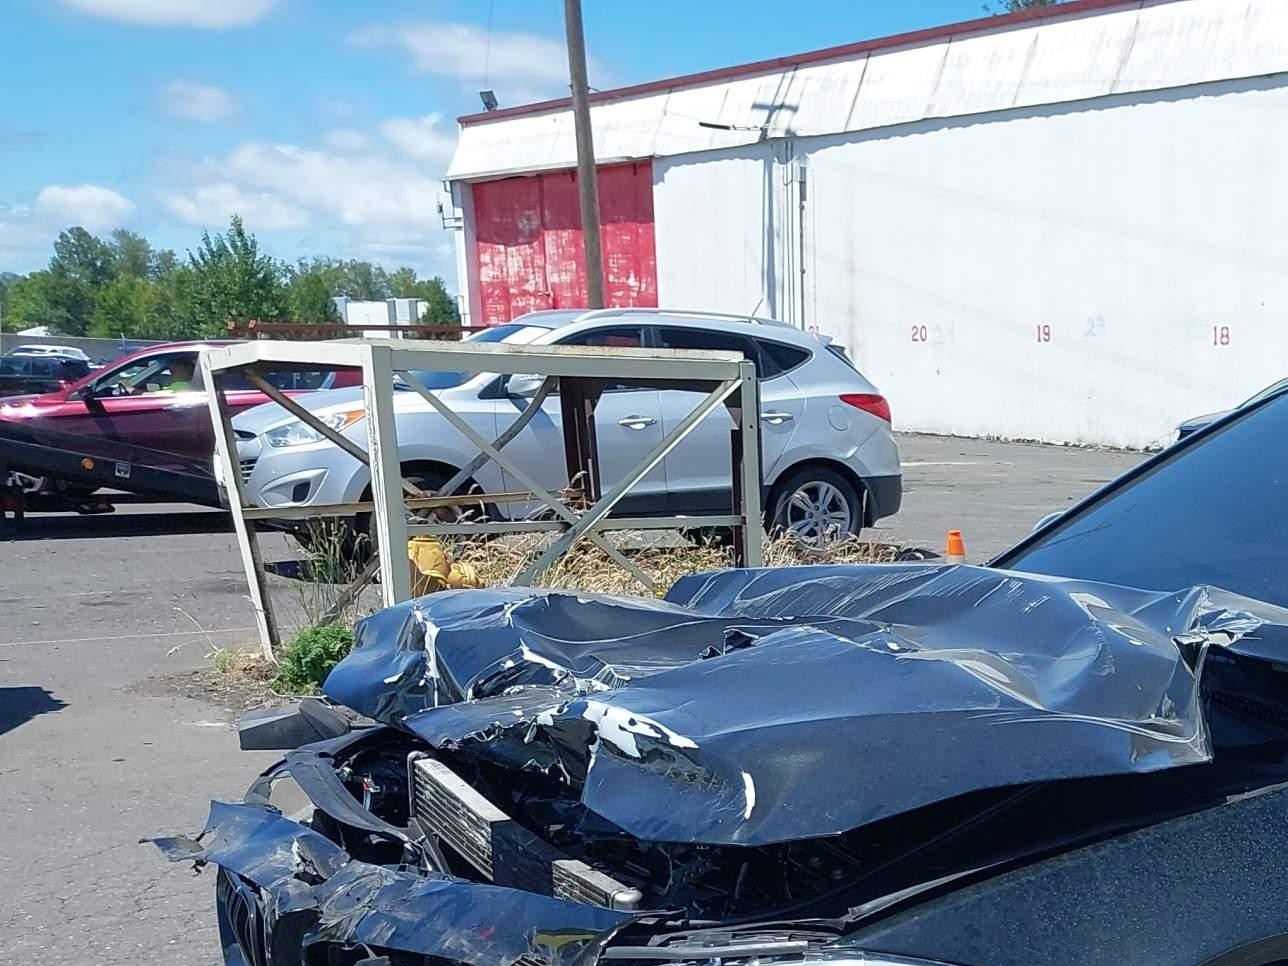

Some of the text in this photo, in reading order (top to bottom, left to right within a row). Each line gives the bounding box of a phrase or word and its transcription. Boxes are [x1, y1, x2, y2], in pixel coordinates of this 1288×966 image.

[911, 325, 927, 342] 20
[1037, 325, 1050, 342] 19
[1213, 325, 1229, 346] 18
